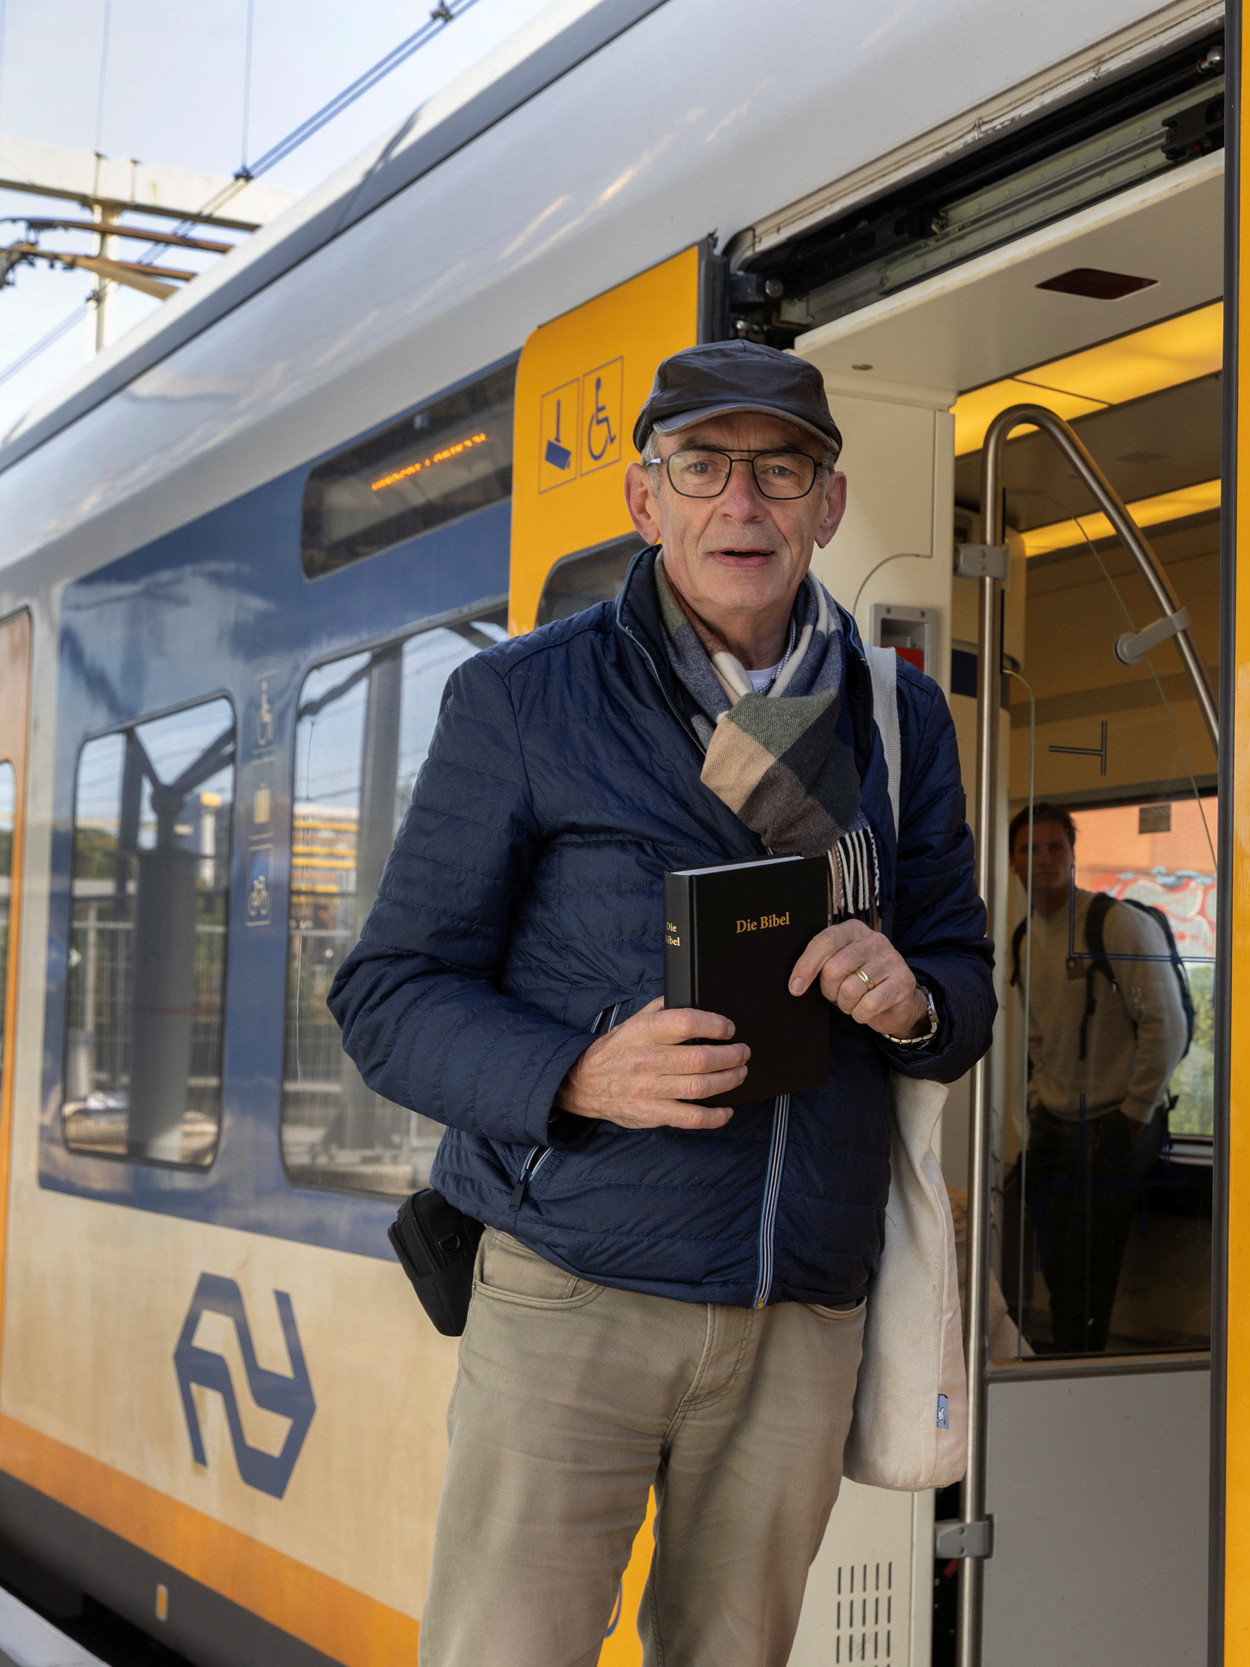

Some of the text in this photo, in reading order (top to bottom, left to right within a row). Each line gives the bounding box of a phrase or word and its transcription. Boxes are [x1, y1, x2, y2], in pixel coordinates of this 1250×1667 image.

[666, 921, 677, 932] Die
[736, 911, 790, 934] Die Bibel
